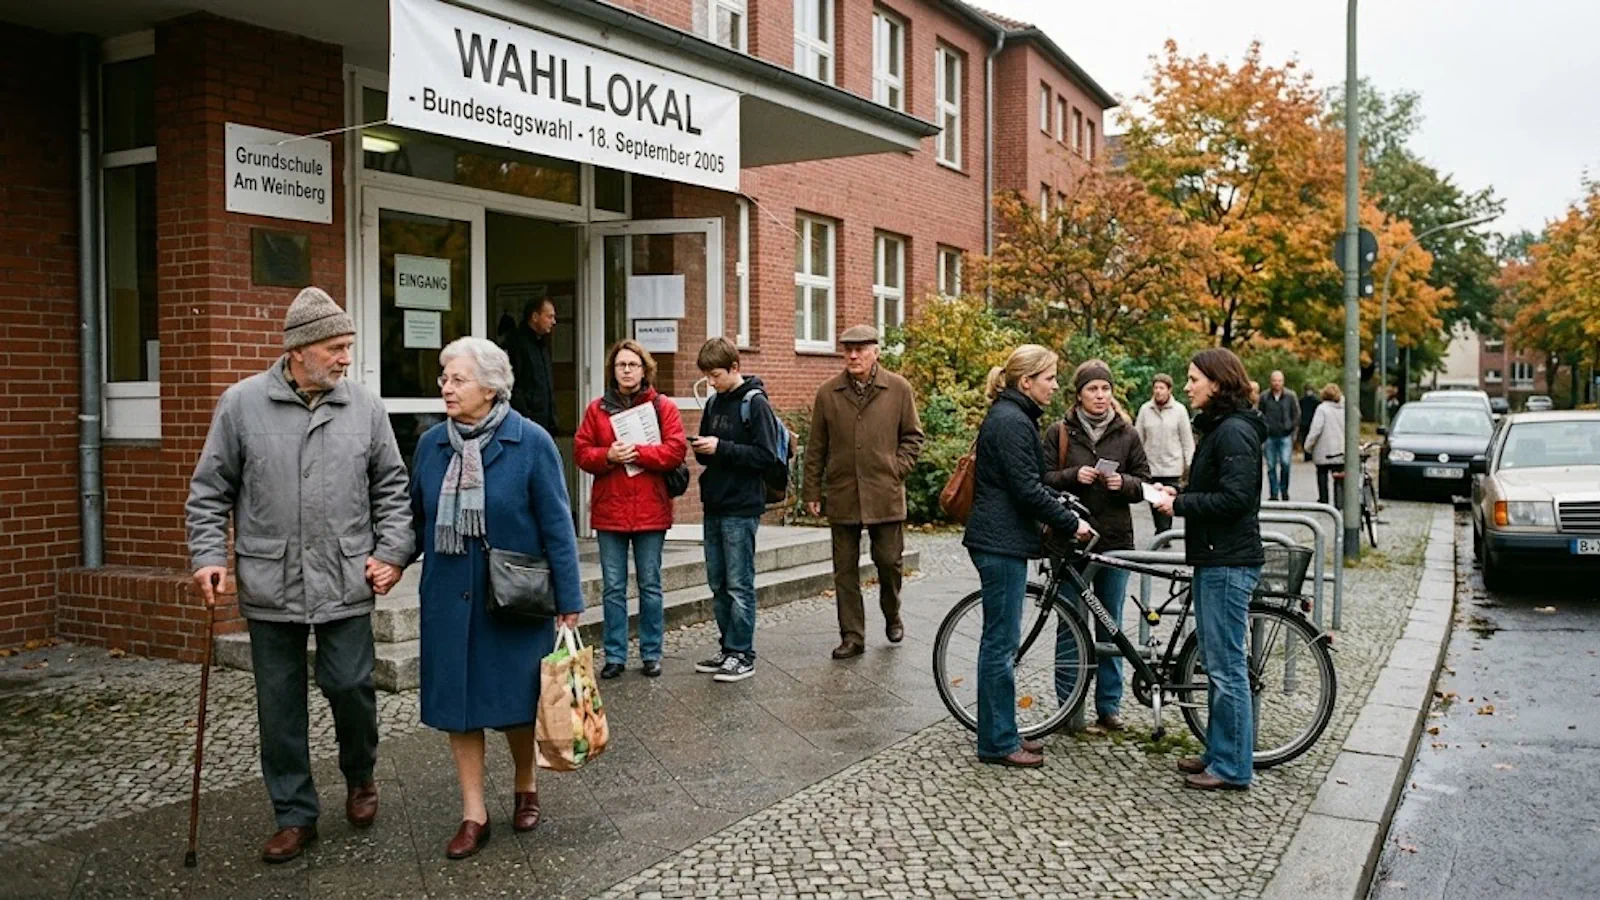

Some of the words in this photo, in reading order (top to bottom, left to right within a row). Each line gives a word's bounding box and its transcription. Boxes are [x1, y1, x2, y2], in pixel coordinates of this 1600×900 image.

[454, 27, 702, 136] WAHLLOKAL
[423, 86, 573, 142] Bundestagswahl
[588, 125, 610, 150] 18.
[615, 131, 690, 166] September
[694, 150, 725, 174] 2005
[236, 146, 323, 176] Grundschule
[234, 172, 257, 191] Am
[261, 175, 325, 205] Weinberg
[399, 273, 447, 291] EINGANG
